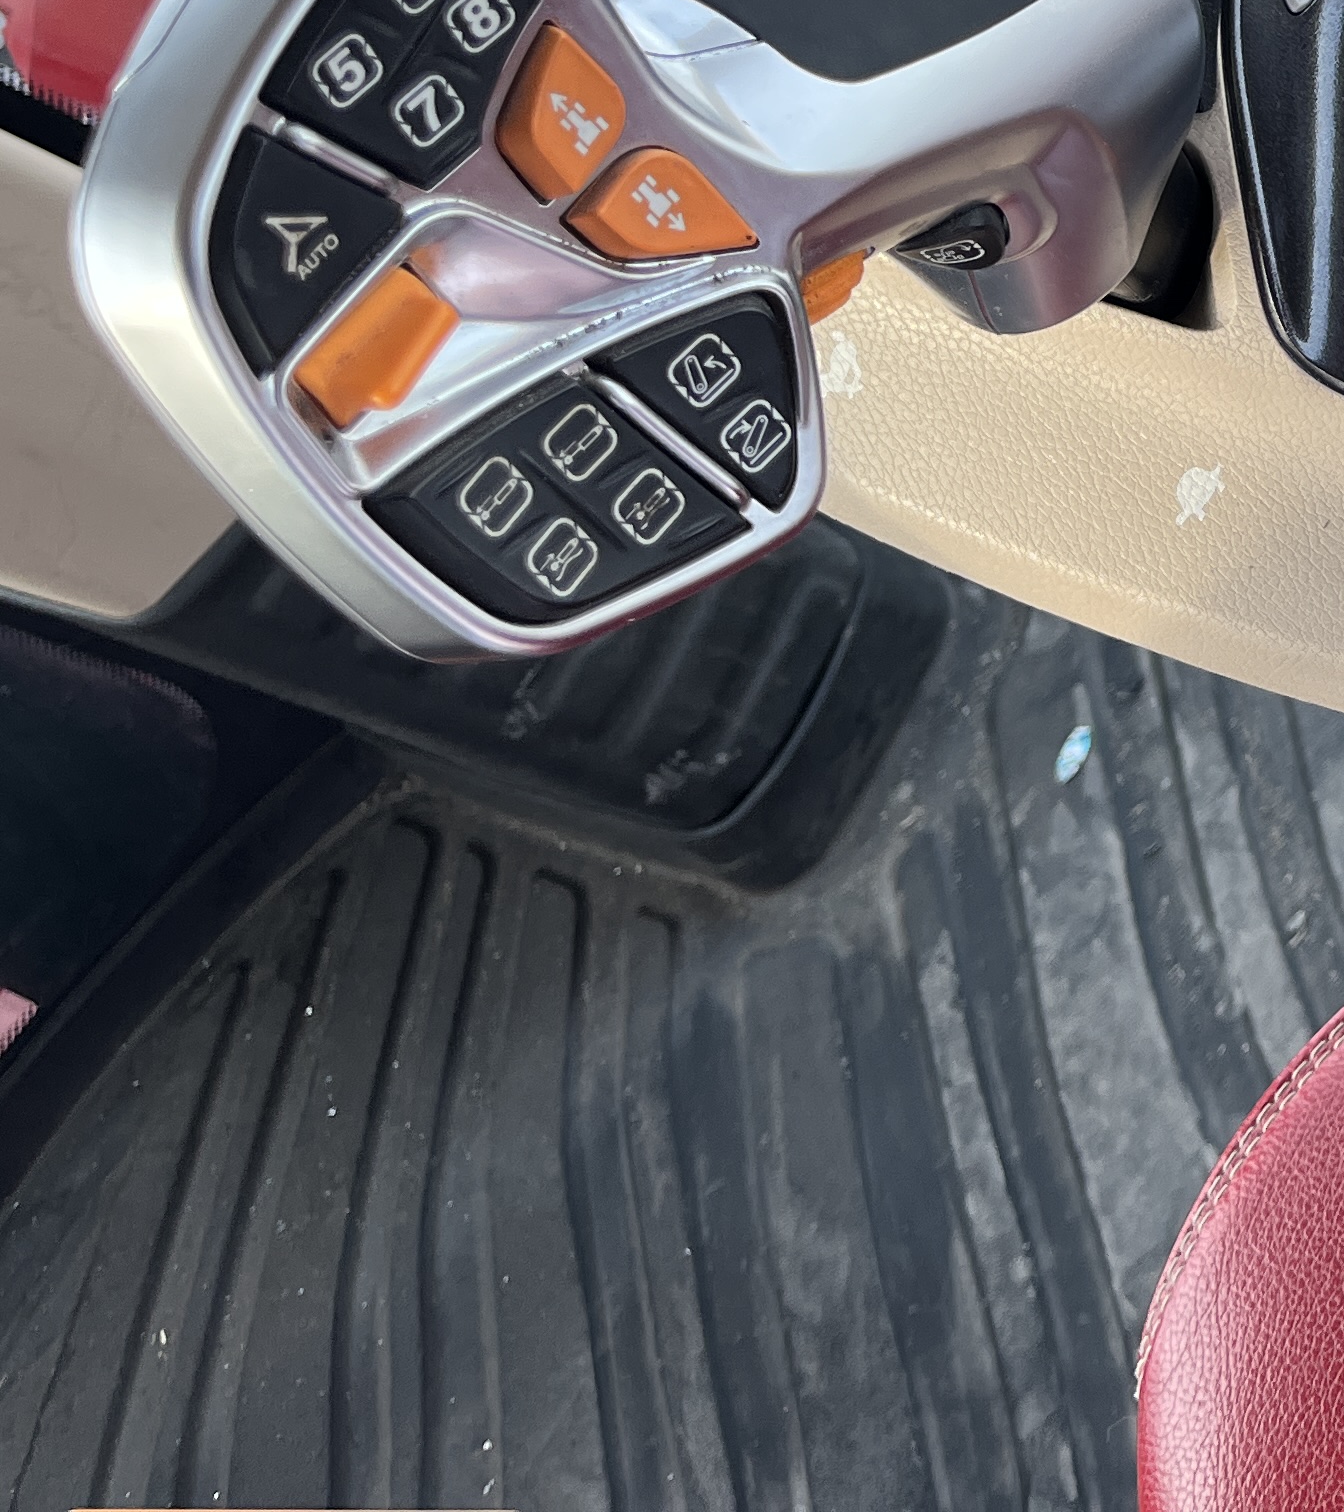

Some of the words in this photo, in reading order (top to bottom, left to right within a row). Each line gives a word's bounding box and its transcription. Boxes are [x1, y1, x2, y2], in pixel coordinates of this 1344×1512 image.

[327, 47, 366, 92] 5
[406, 85, 442, 132] 7
[297, 233, 340, 281] AUTO
